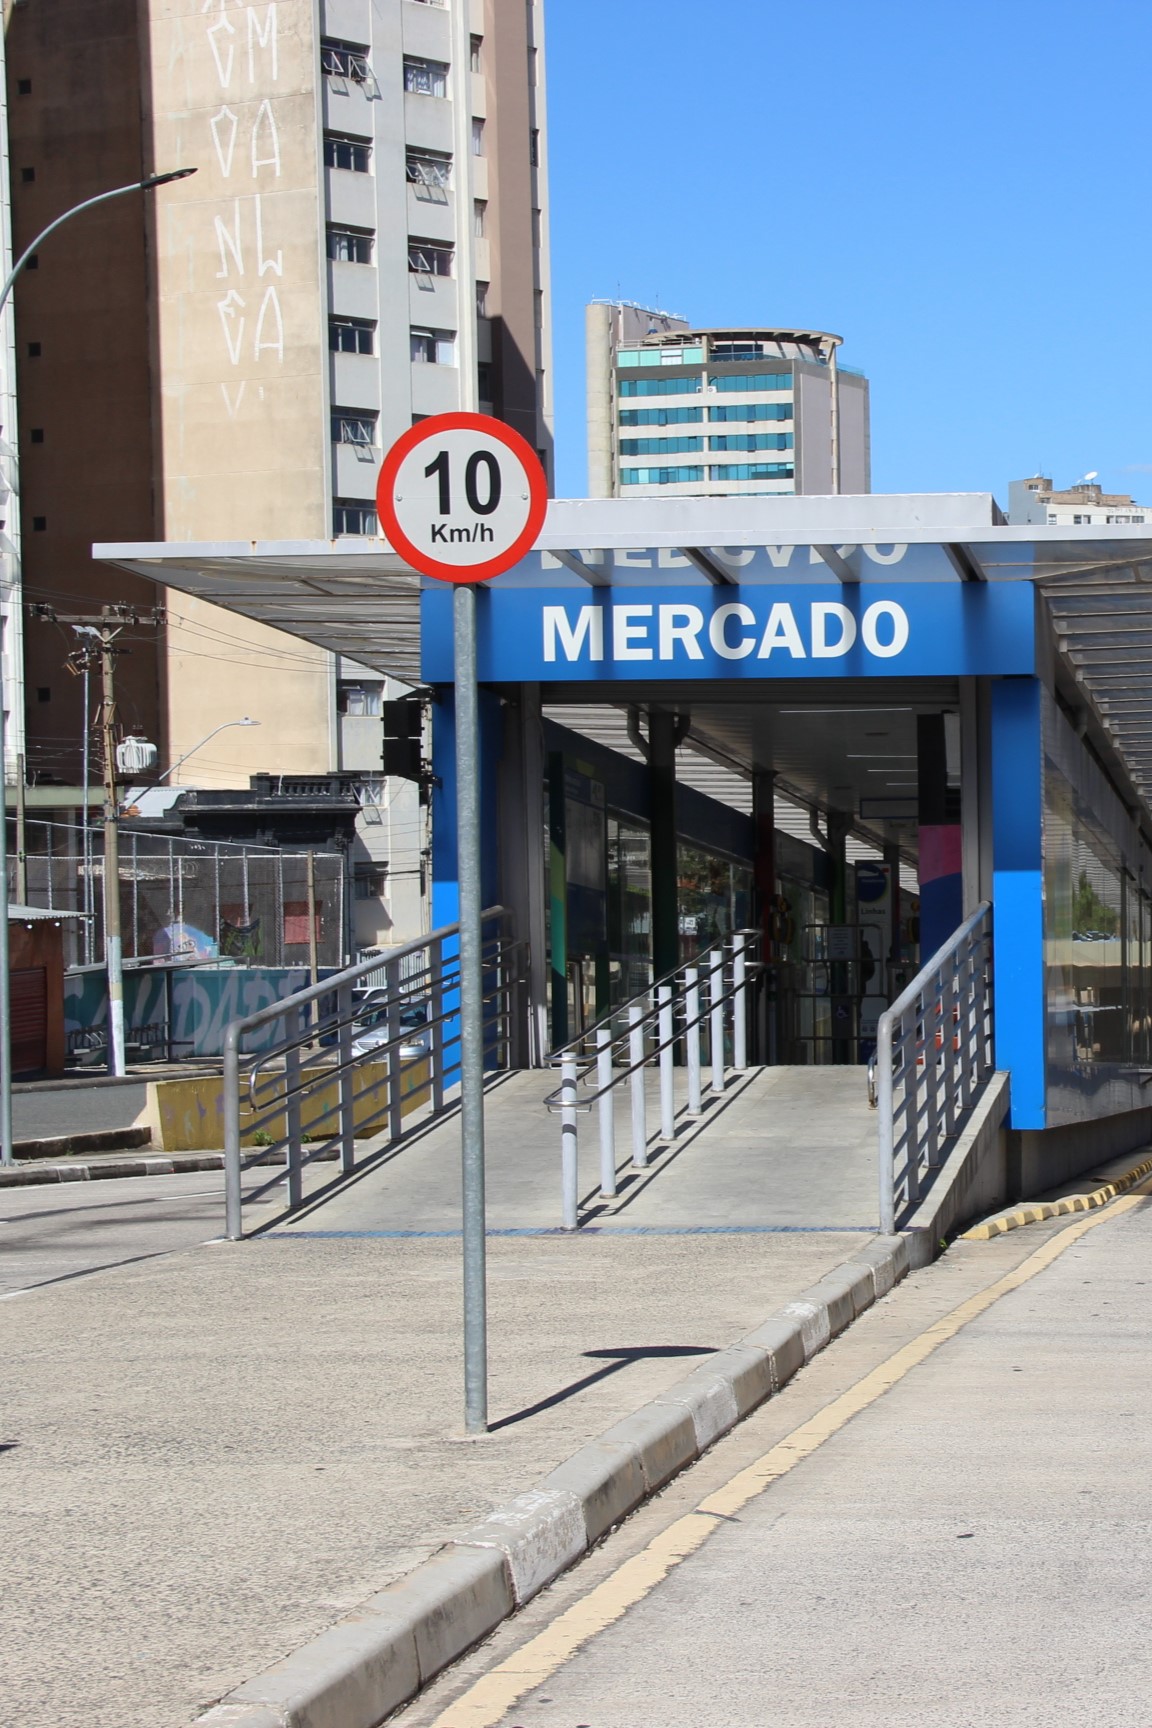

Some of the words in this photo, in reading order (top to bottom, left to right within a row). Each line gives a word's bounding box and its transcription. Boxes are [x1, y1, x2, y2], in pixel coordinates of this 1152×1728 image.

[425, 450, 501, 515] 10
[431, 523, 494, 543] Km/h
[543, 600, 909, 662] MERCADO
